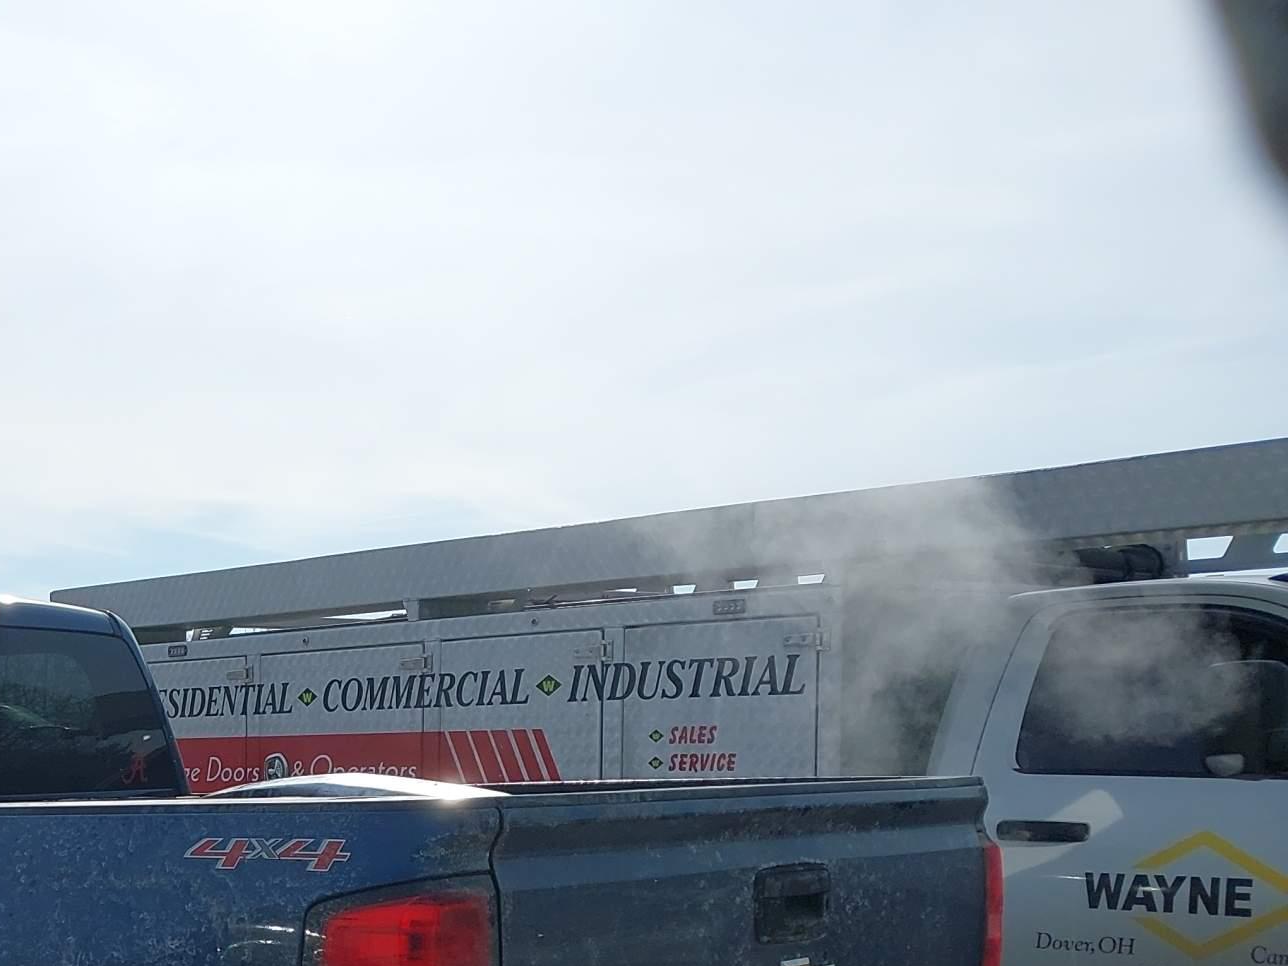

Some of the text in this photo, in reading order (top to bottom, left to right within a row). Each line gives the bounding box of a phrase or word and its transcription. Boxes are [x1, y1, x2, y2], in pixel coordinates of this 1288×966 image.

[322, 668, 530, 713] COMMERCIAL
[567, 654, 806, 703] INDUSTRIAL
[668, 725, 718, 744] SALES
[206, 756, 260, 782] Doors
[290, 760, 305, 777] &
[668, 753, 737, 773] SERVICE
[1084, 871, 1254, 918] WAYNE
